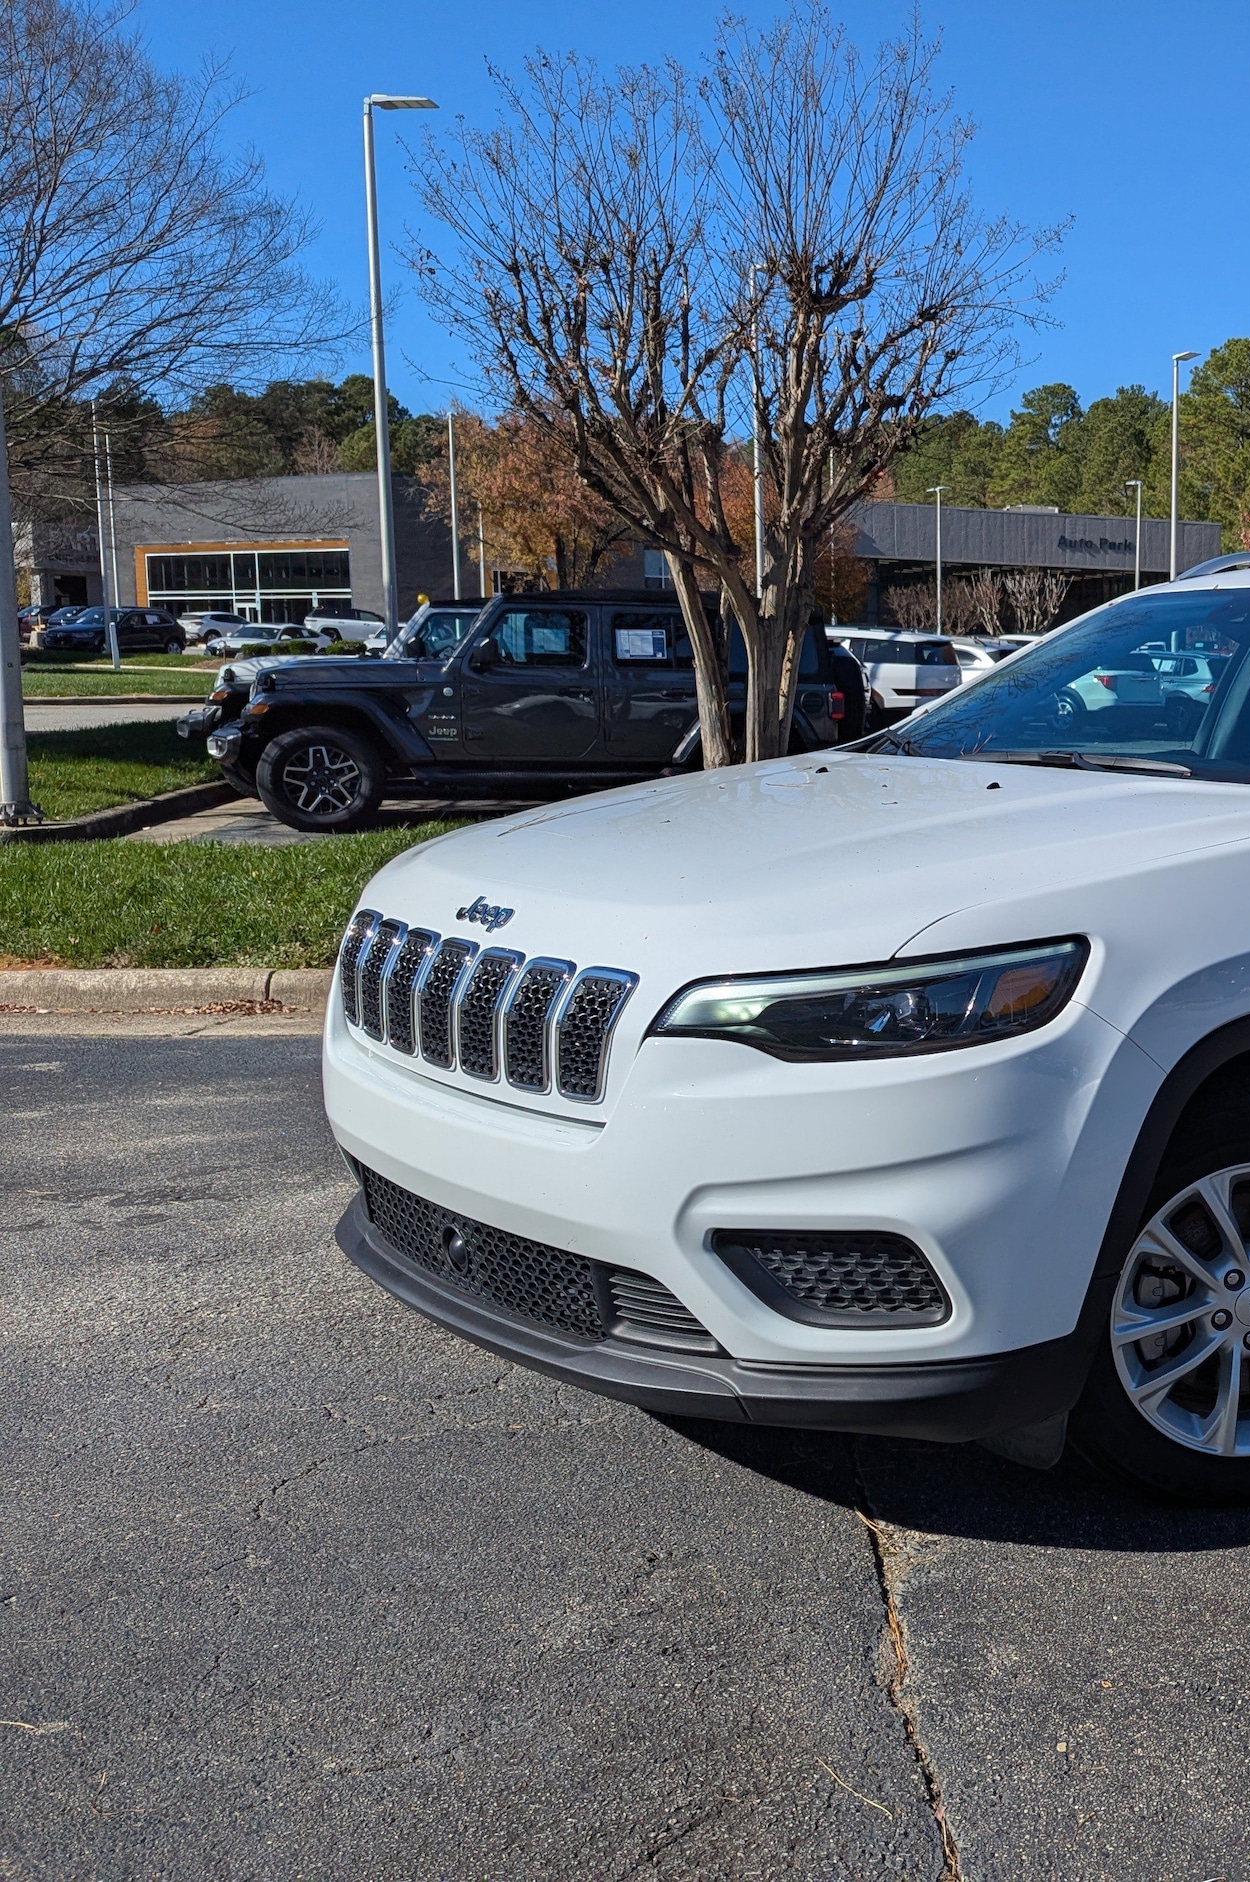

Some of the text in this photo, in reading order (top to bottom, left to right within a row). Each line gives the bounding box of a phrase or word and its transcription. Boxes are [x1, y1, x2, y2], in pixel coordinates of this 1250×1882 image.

[1057, 535, 1133, 551] Auto Park
[428, 726, 458, 737] Jeep
[456, 895, 515, 934] Jeep
